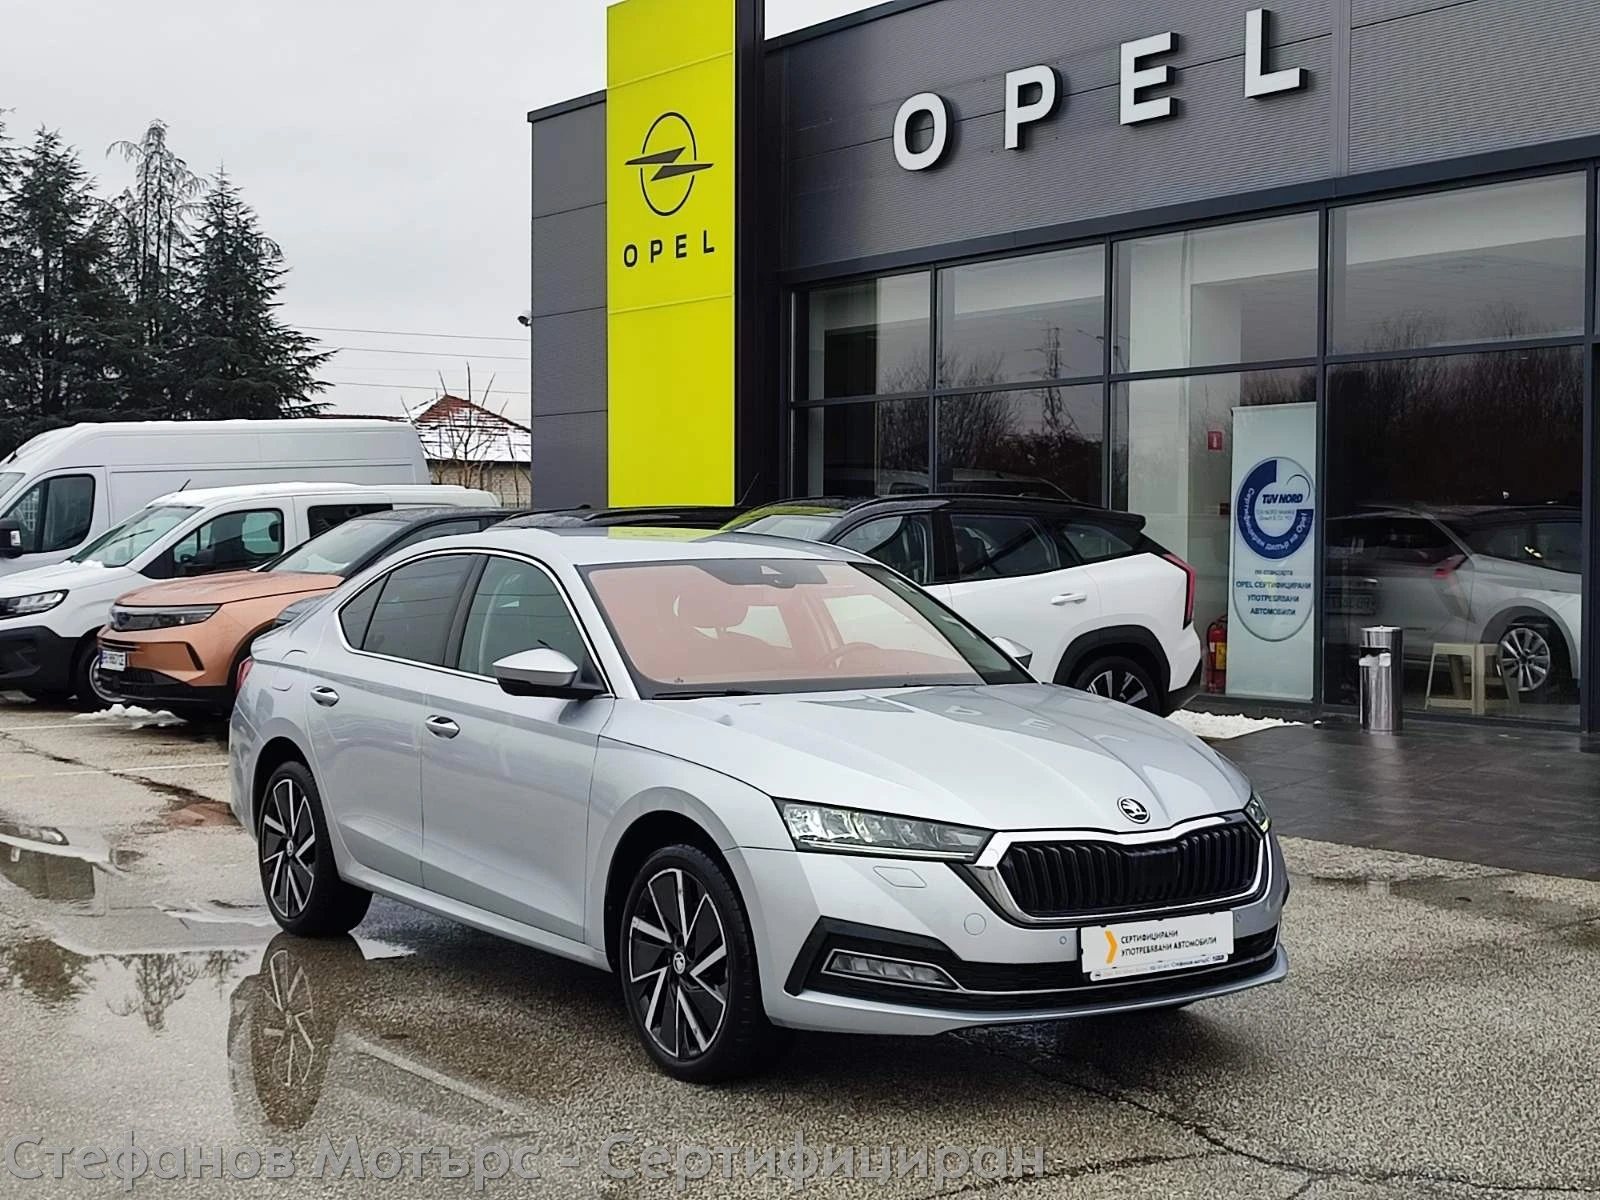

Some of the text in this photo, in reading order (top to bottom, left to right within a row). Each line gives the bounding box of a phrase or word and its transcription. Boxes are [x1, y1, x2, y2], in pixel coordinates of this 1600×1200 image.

[893, 8, 1306, 171] OPEL
[623, 229, 715, 268] OPEL
[1262, 493, 1304, 504] TÜV NORD
[1235, 581, 1312, 590] OPEL СЕРТИФИЦИРАНИ
[1249, 607, 1296, 615] АВТОМОБИЛИ
[1120, 930, 1179, 944] СЕРТИФИЦИРАНИ
[1121, 936, 1217, 957] УПОТРЕБЯВАНИ АВТОМОБИЛИ
